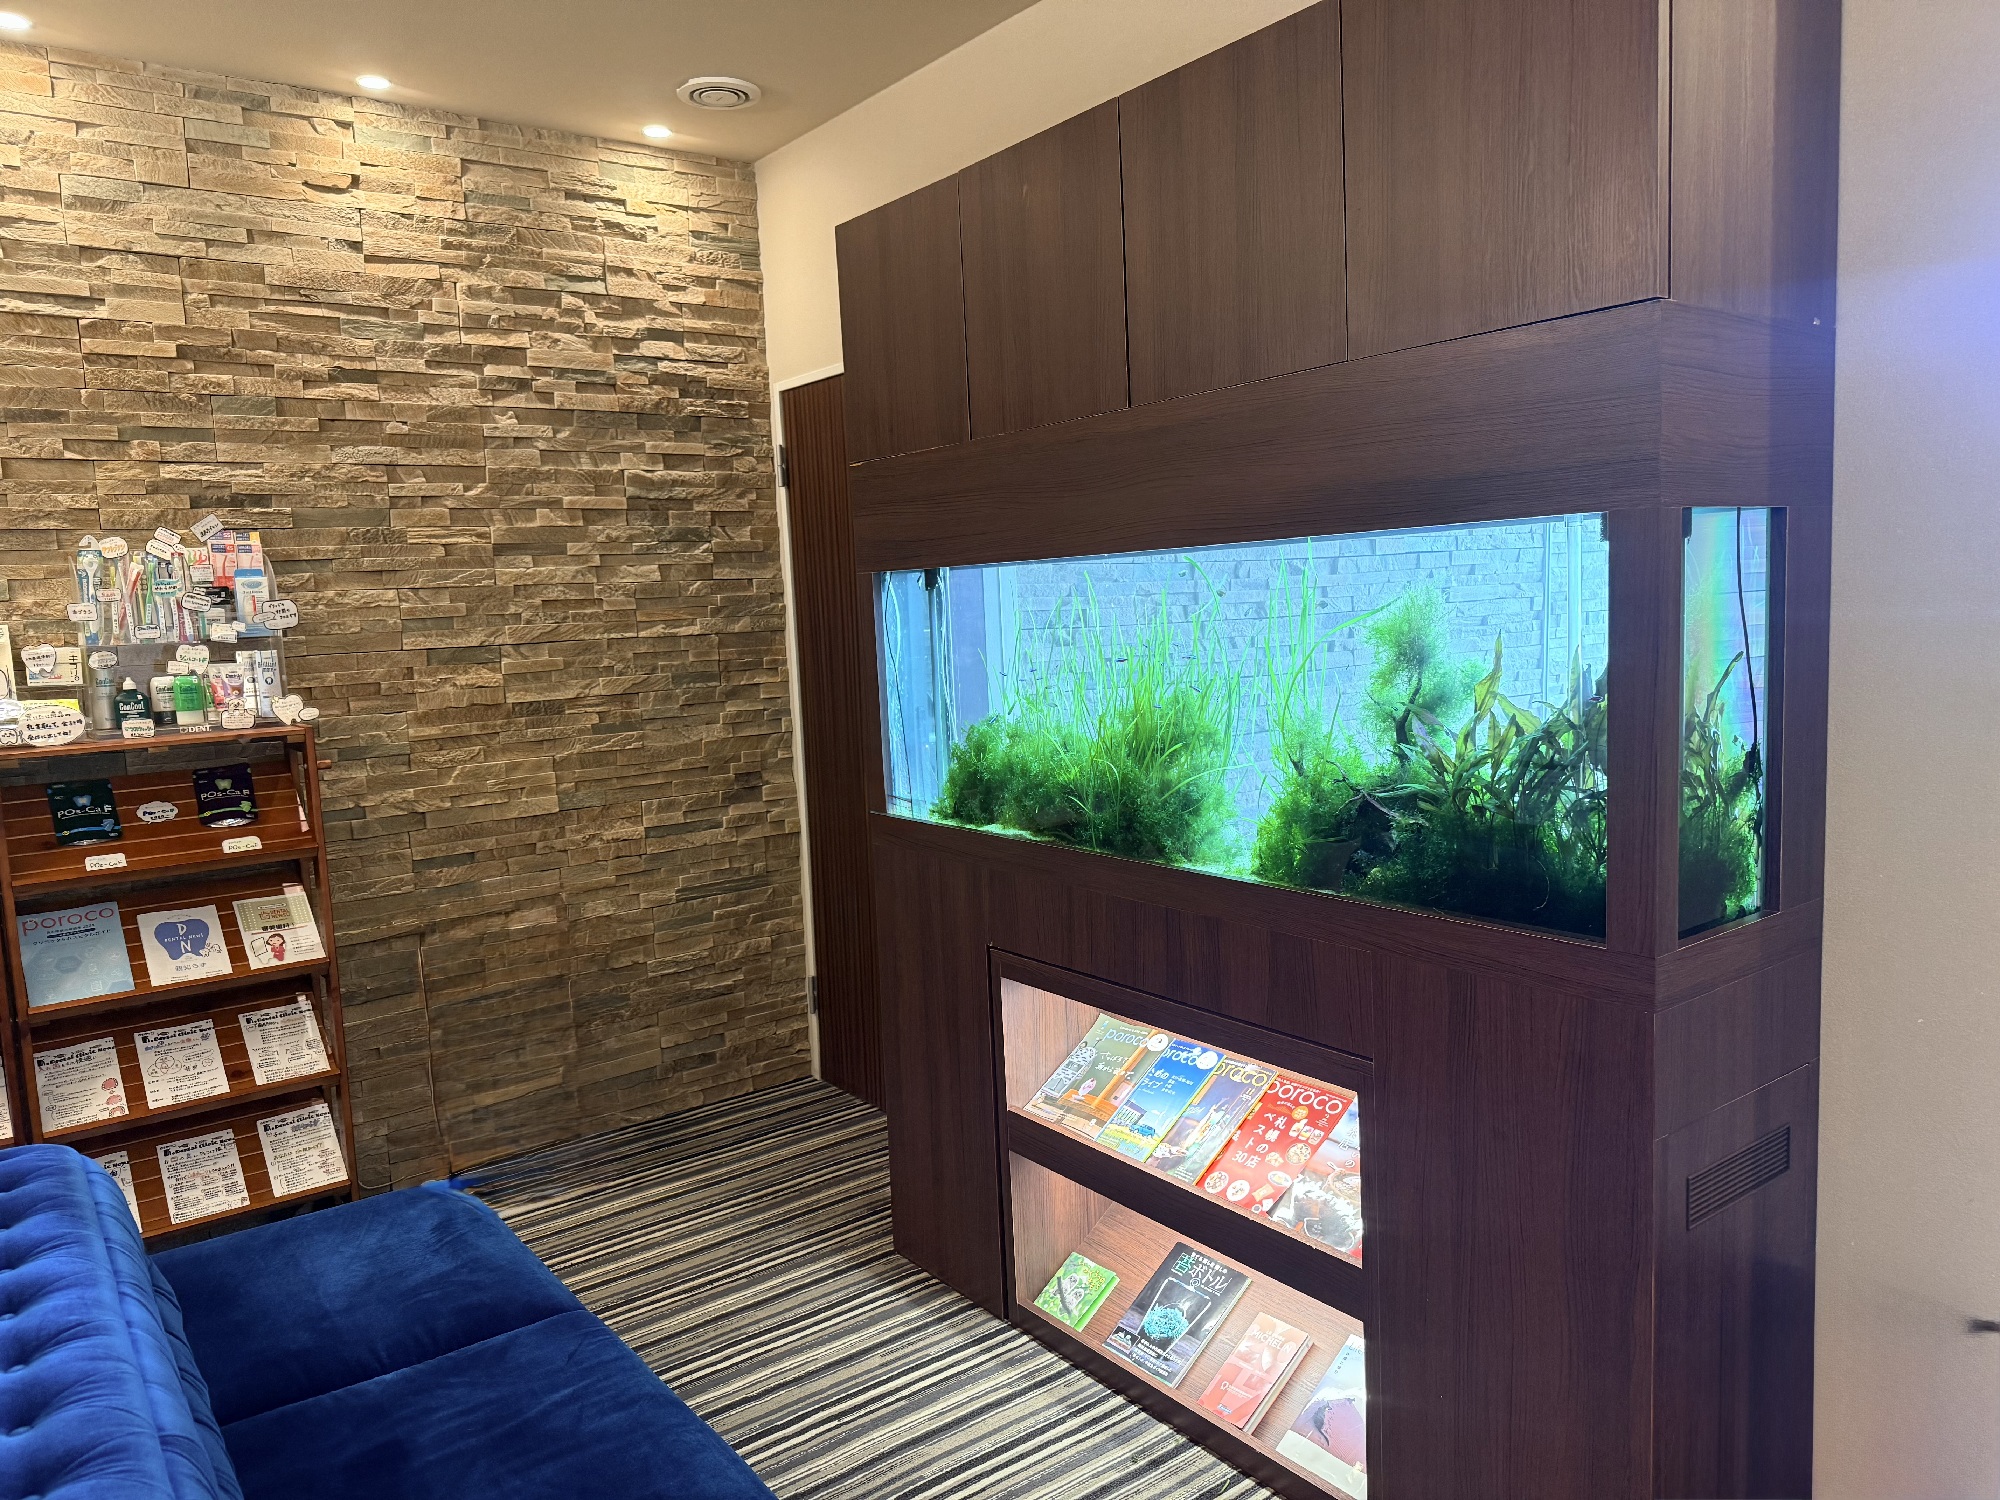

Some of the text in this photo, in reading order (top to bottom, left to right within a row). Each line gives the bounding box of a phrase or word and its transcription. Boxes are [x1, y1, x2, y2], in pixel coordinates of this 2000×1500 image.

[22, 908, 114, 937] poroco
[1102, 1028, 1148, 1046] poroco
[1248, 1329, 1293, 1353] MICHELIN
